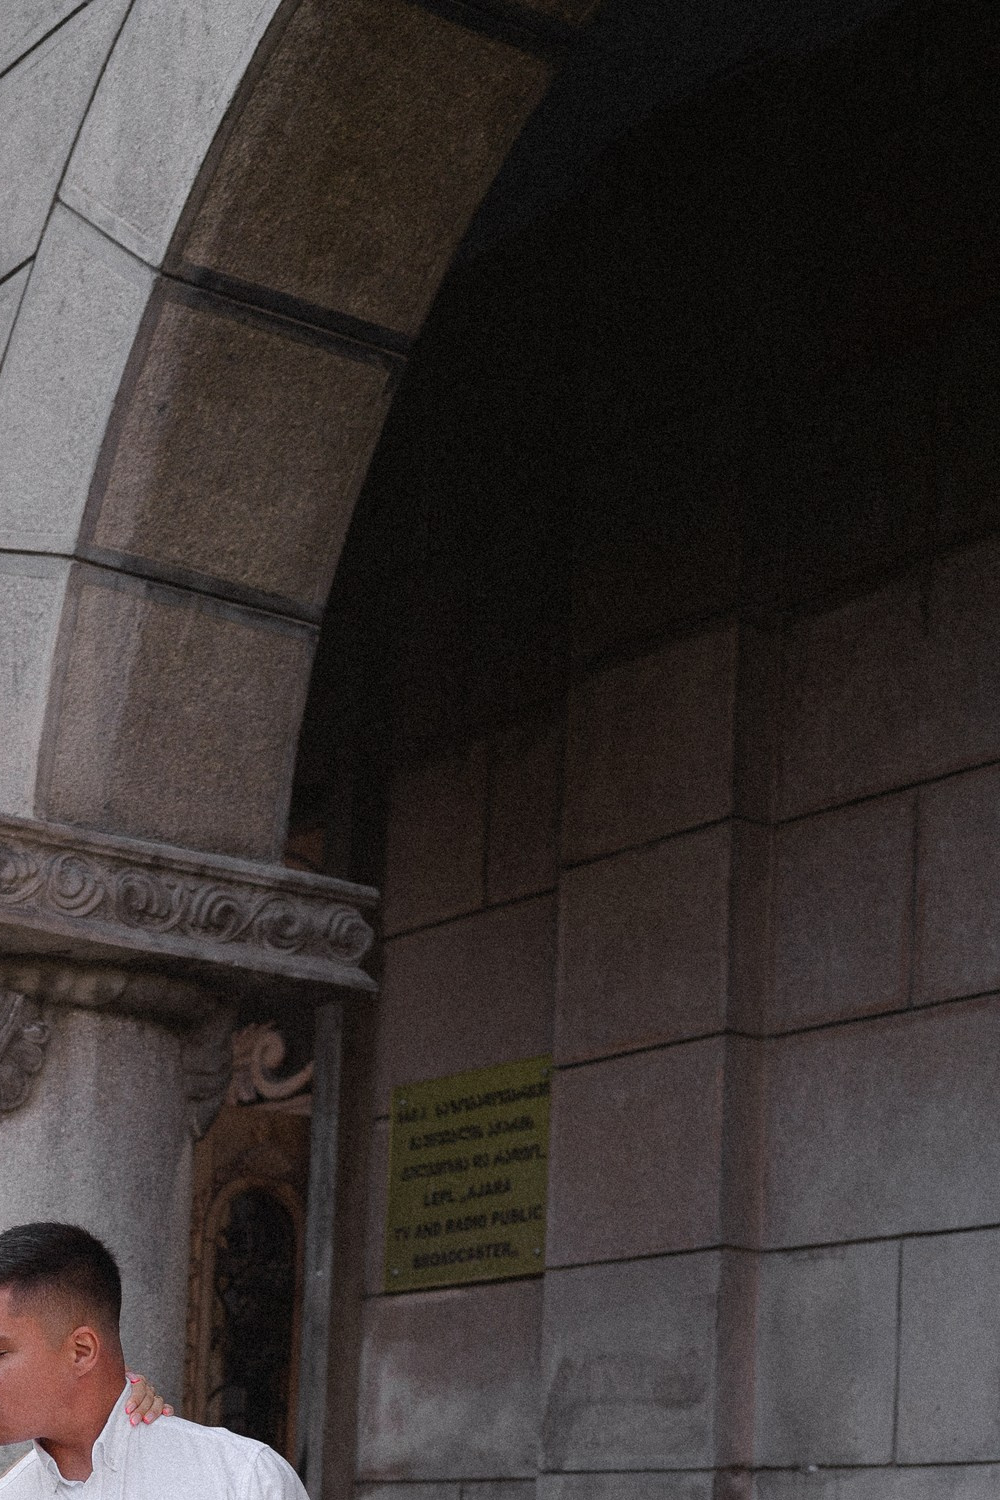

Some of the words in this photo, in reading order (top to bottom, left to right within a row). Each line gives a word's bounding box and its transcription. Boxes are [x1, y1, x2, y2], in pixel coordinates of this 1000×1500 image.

[394, 1226, 411, 1241] TV
[414, 1222, 442, 1239] AND
[445, 1214, 487, 1235] RADIO
[491, 1205, 543, 1226] PUBLIC
